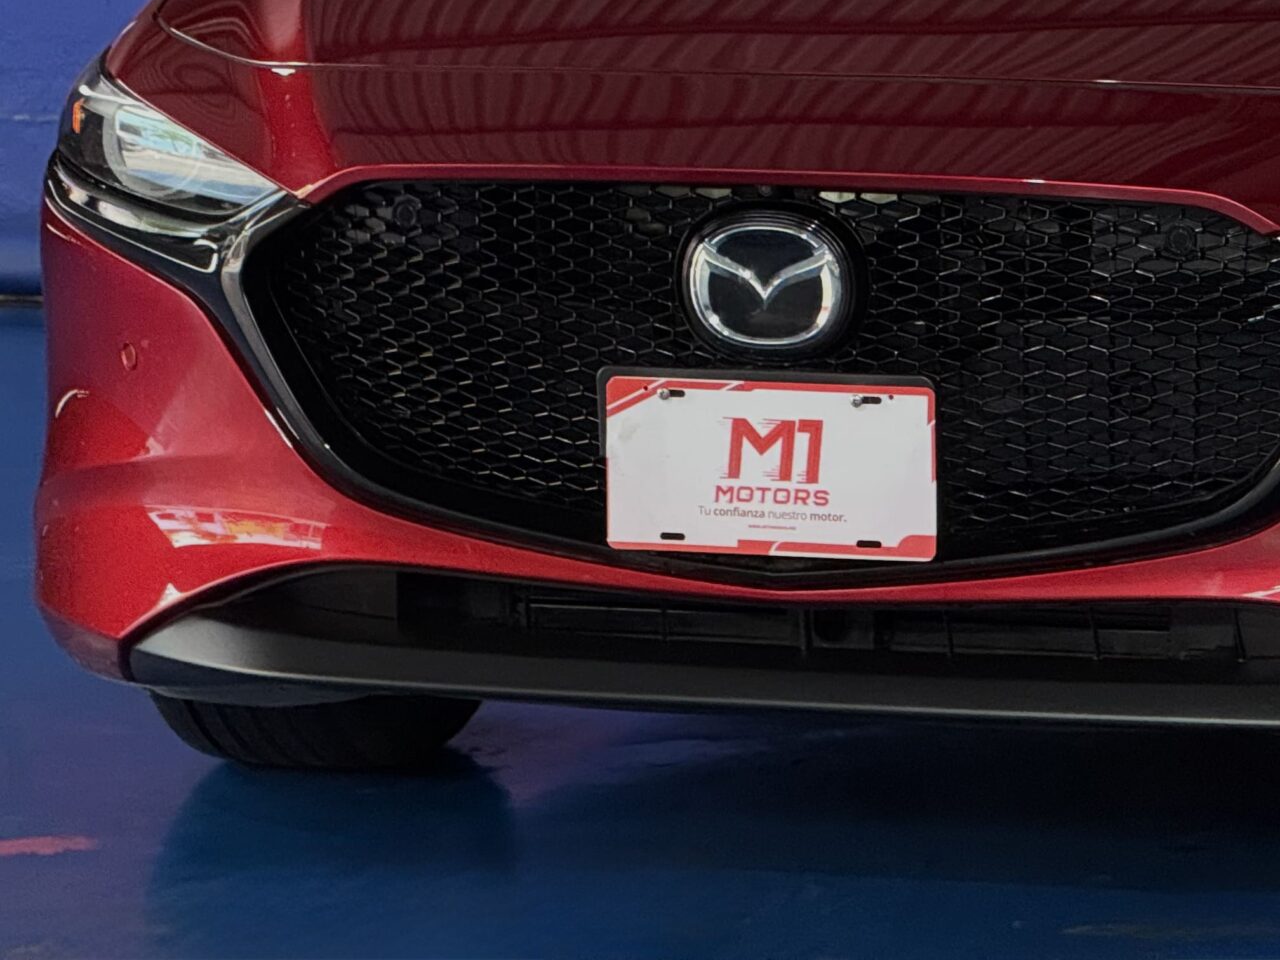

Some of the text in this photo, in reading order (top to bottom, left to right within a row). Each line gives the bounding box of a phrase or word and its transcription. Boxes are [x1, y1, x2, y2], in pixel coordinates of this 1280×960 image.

[722, 416, 824, 484] M1
[714, 485, 830, 506] MOTORS
[698, 505, 848, 523] Tu confianza nuestro motor.
